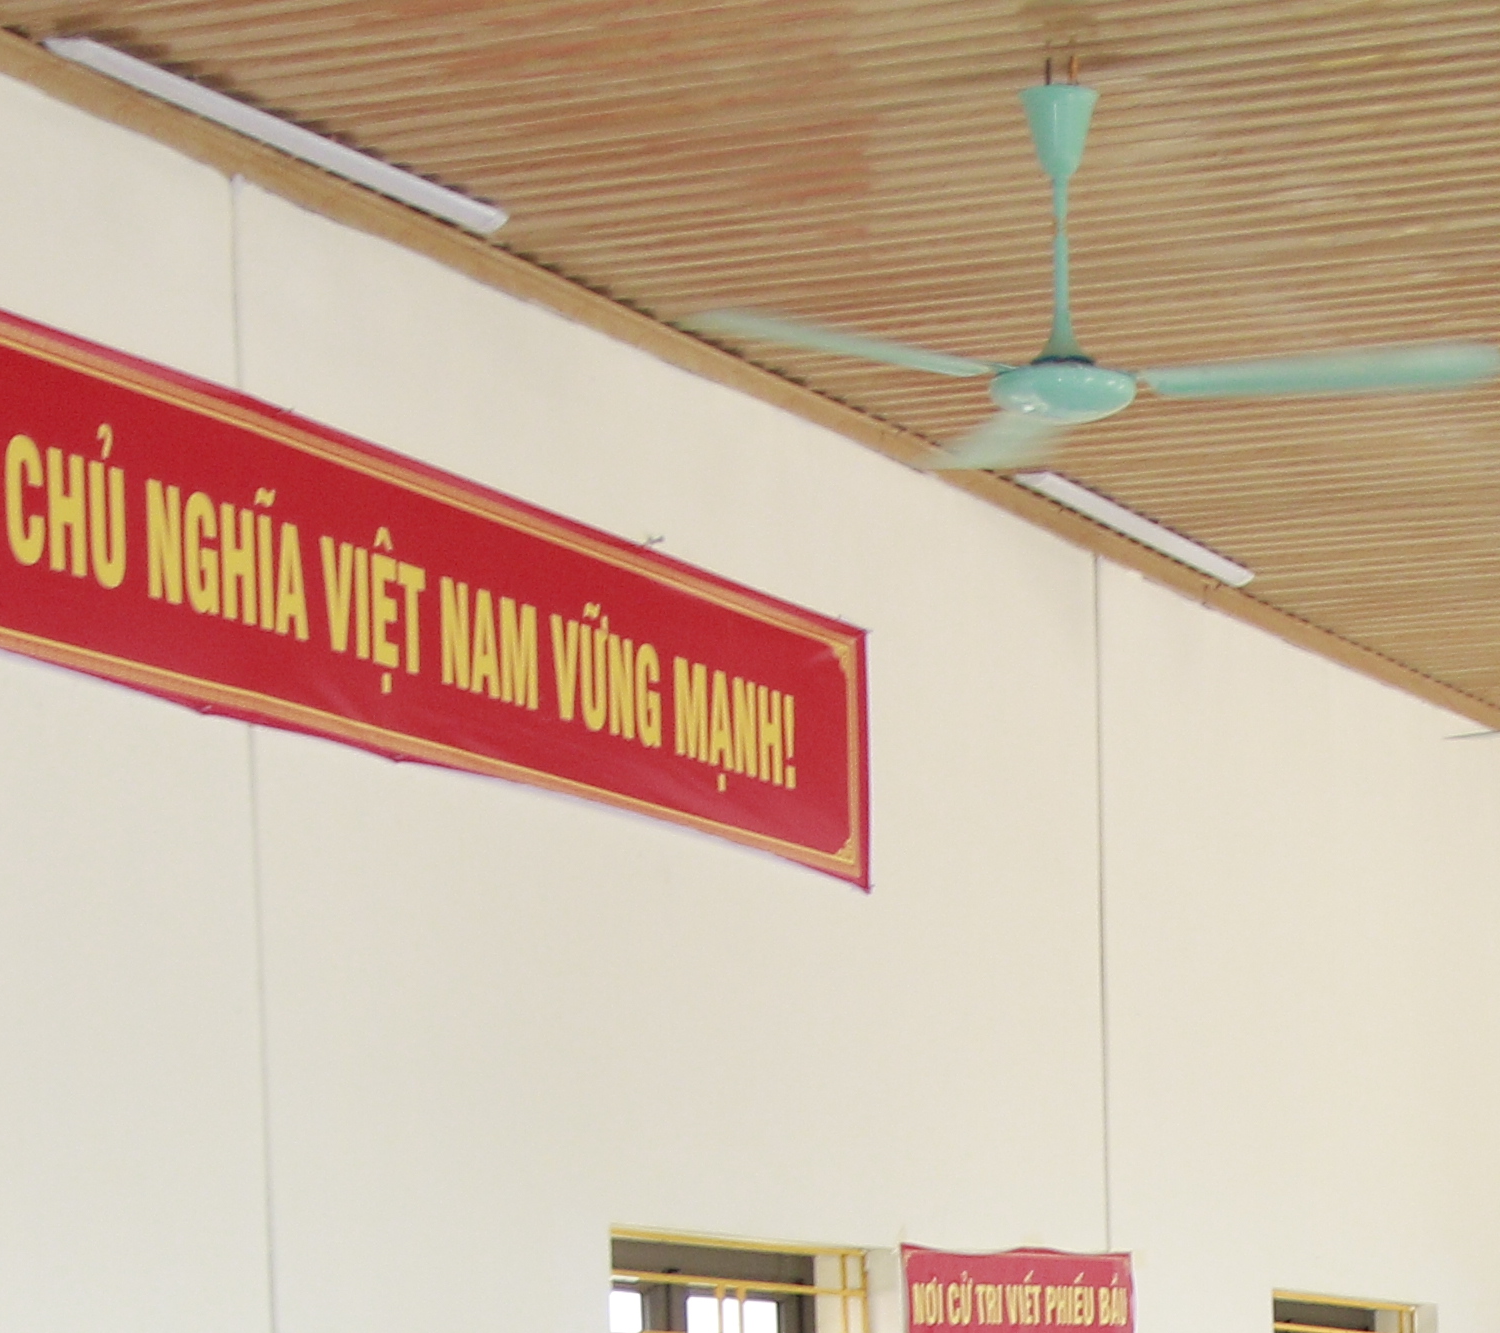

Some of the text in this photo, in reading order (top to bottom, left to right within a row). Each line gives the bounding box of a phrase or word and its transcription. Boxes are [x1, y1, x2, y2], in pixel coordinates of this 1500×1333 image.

[5, 423, 127, 589] CHỦ
[146, 479, 309, 641] NGHĨA
[320, 527, 426, 694] VIỆT
[440, 576, 539, 711] NAM
[550, 602, 662, 748] VỮNG
[673, 655, 797, 791] MẠNH!
[975, 1284, 1003, 1326] TRI
